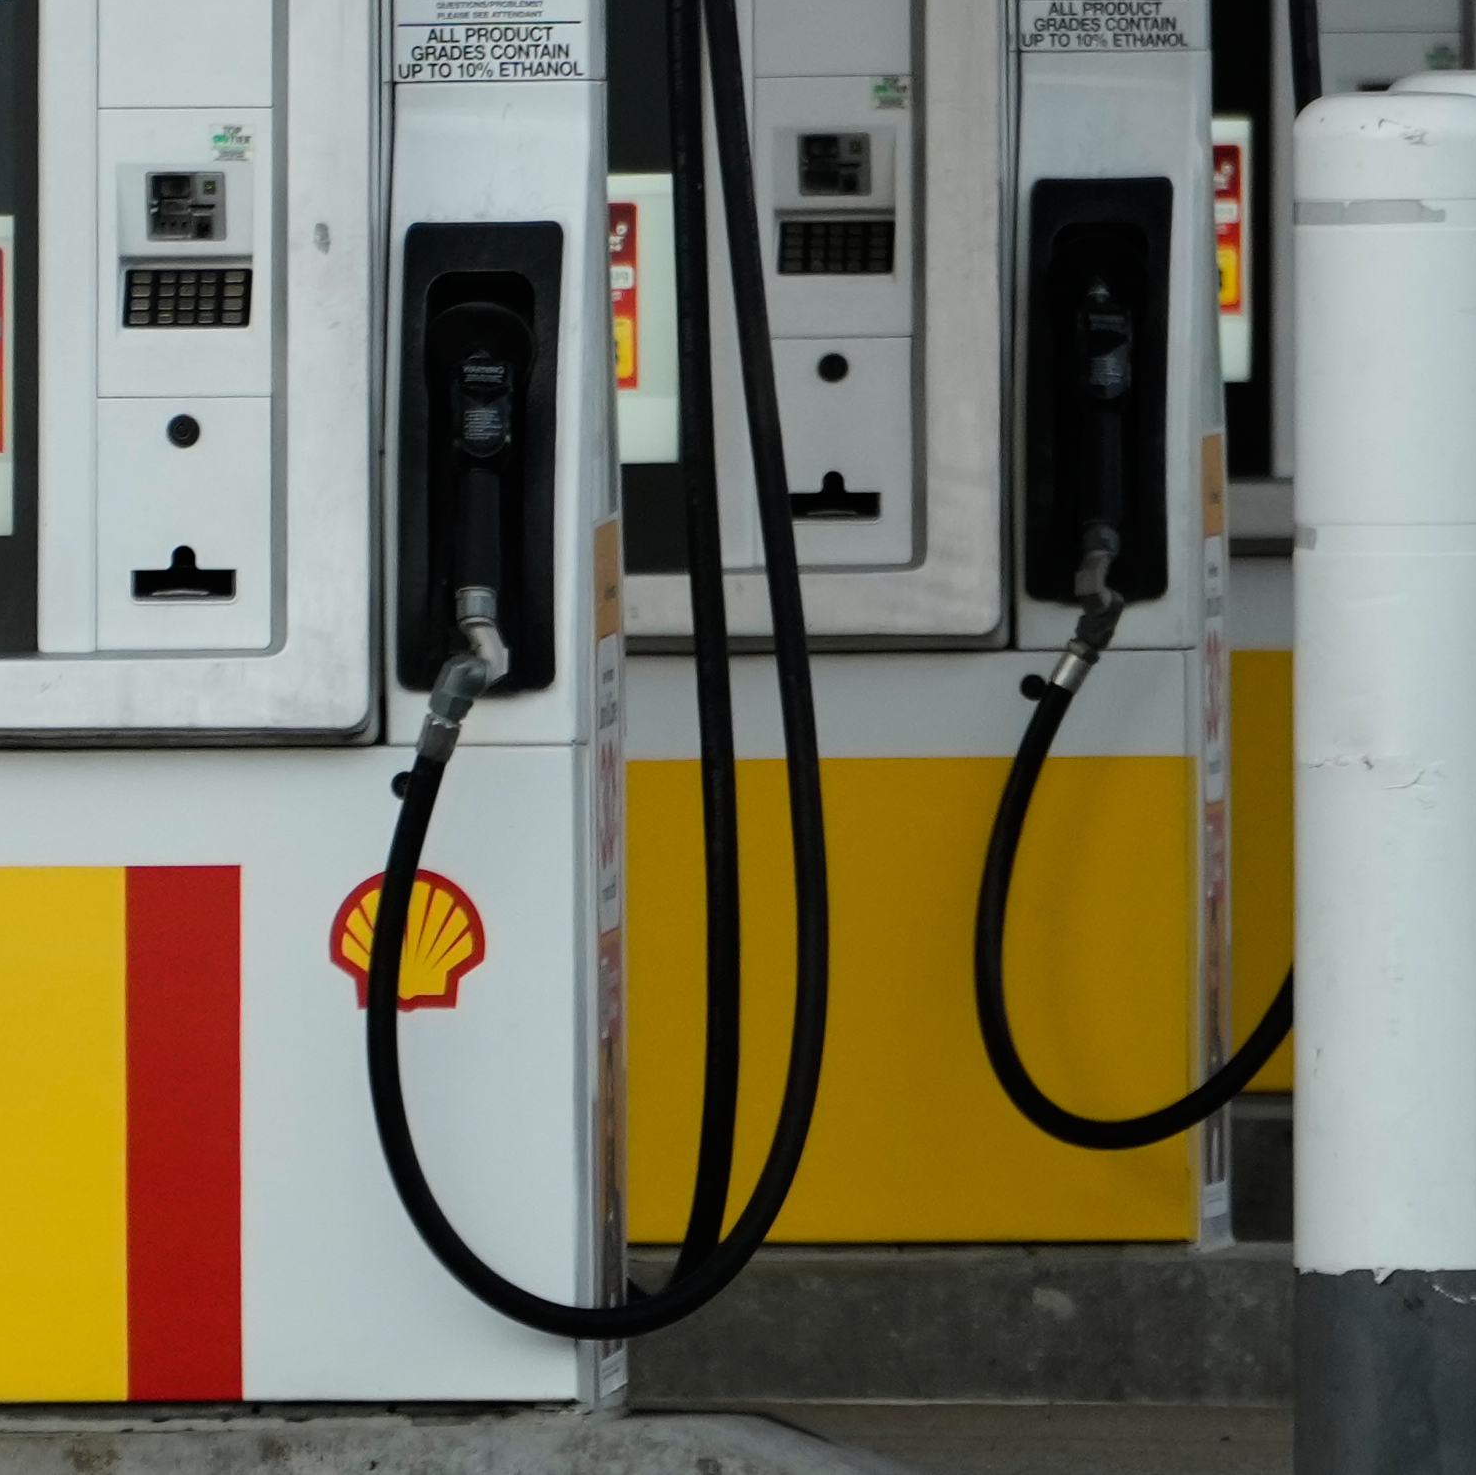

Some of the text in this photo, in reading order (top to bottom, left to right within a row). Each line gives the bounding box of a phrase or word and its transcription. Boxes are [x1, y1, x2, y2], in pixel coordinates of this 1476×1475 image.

[1049, 1, 1163, 17] ALL PRODUCT
[1034, 17, 1177, 32] GRADES CONTAIN
[426, 26, 554, 44] ALL PRODUCT
[1022, 33, 1188, 48] UP TO 10% ETHANOL
[411, 44, 570, 61] GRADES CONTAIN
[398, 61, 584, 79] UP TO 10% ETHANOL
